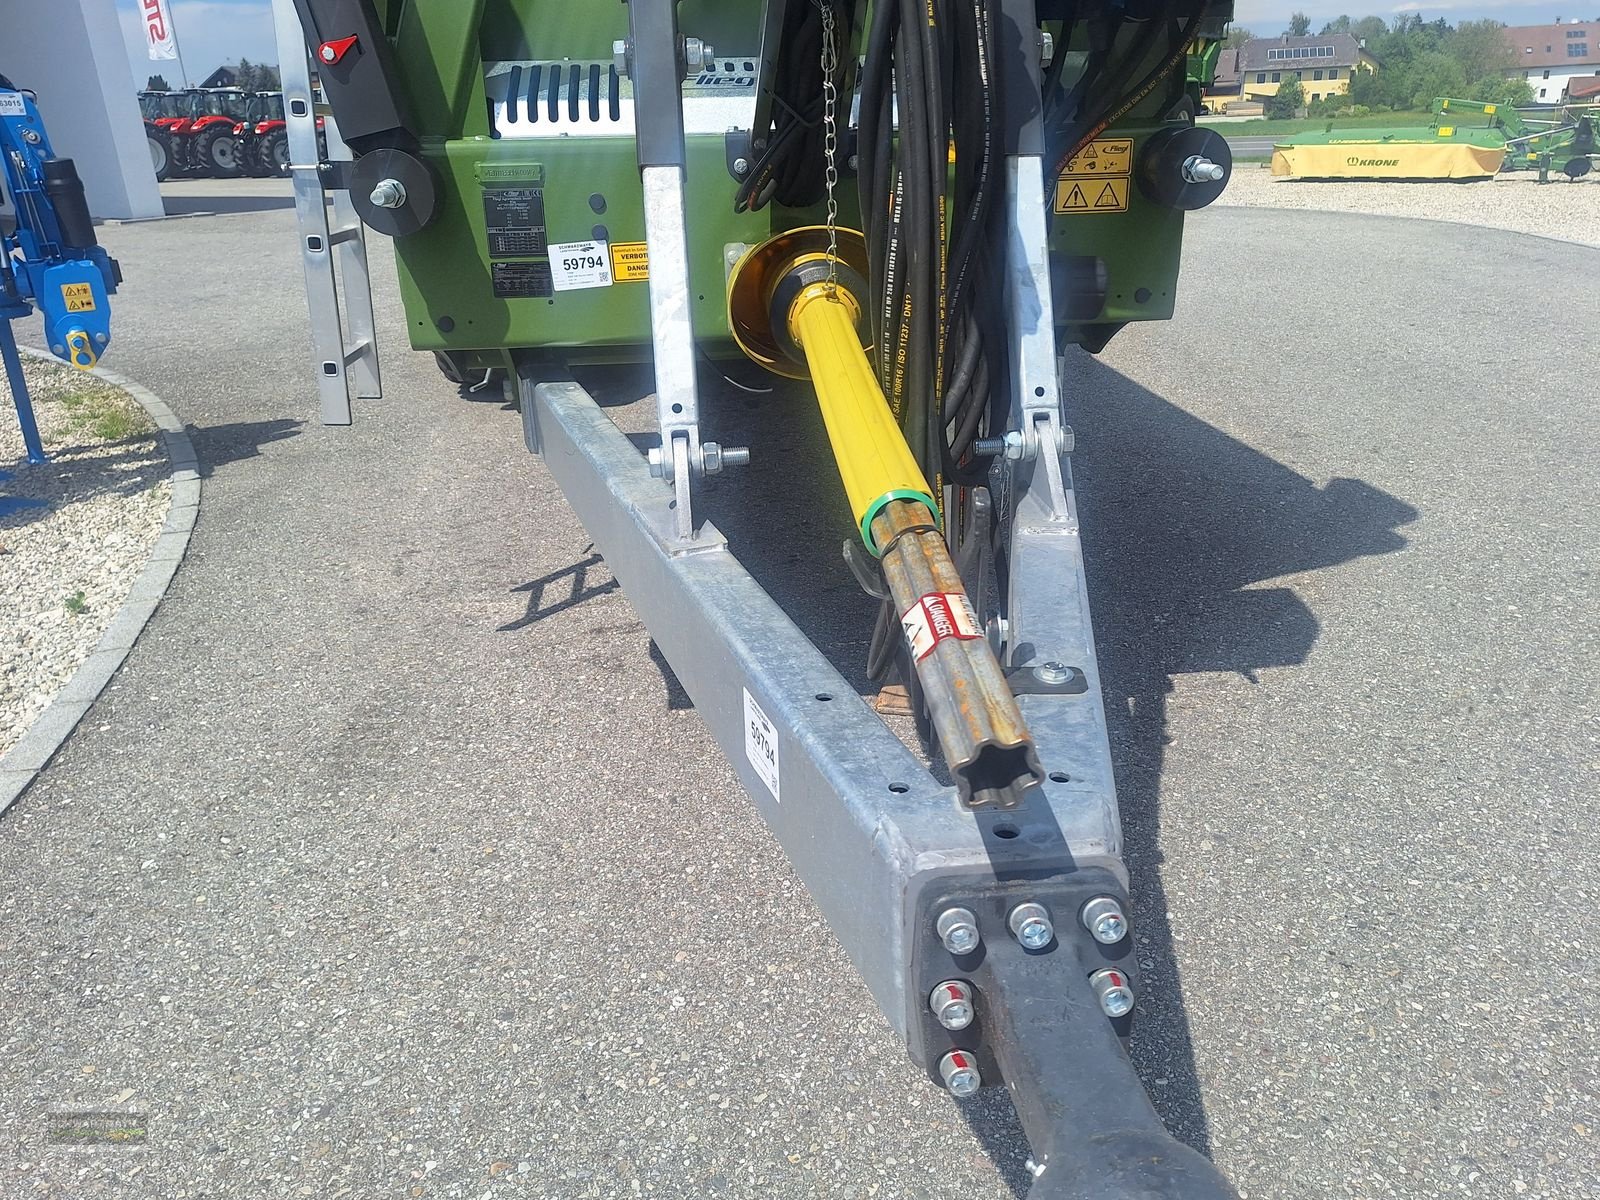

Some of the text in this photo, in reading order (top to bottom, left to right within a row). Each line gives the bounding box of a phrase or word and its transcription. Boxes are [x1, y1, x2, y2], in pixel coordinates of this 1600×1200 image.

[685, 74, 755, 86] lieg
[1109, 102, 1132, 123] EXCEEDS
[1131, 94, 1141, 105] DIN
[563, 255, 604, 271] 59794
[900, 324, 909, 348] 11237
[898, 349, 906, 364] ISO
[895, 369, 904, 396] 100R16
[893, 397, 901, 413] SAE
[928, 604, 954, 637] DANGER
[751, 720, 775, 767] 59794
